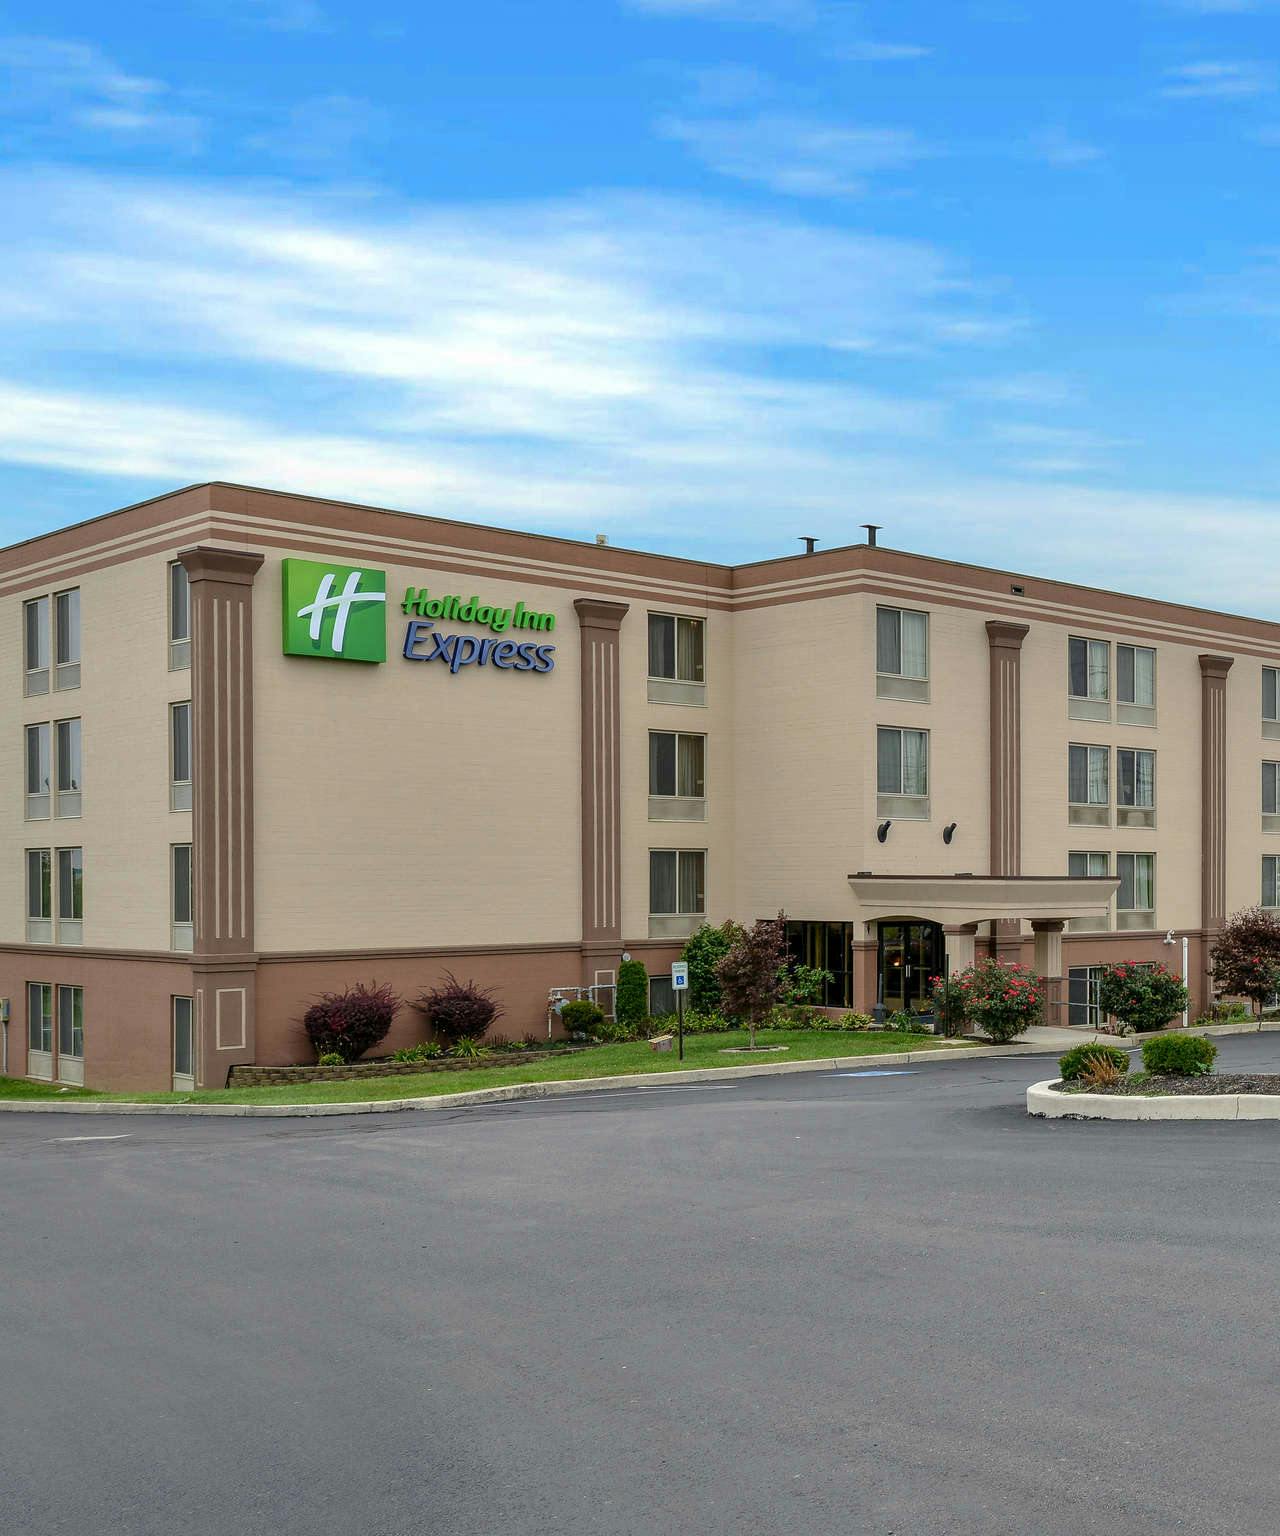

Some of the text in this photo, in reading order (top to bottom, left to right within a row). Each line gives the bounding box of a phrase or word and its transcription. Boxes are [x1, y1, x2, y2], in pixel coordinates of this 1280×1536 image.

[400, 586, 556, 632] Holiday Inn
[403, 620, 556, 674] Express
